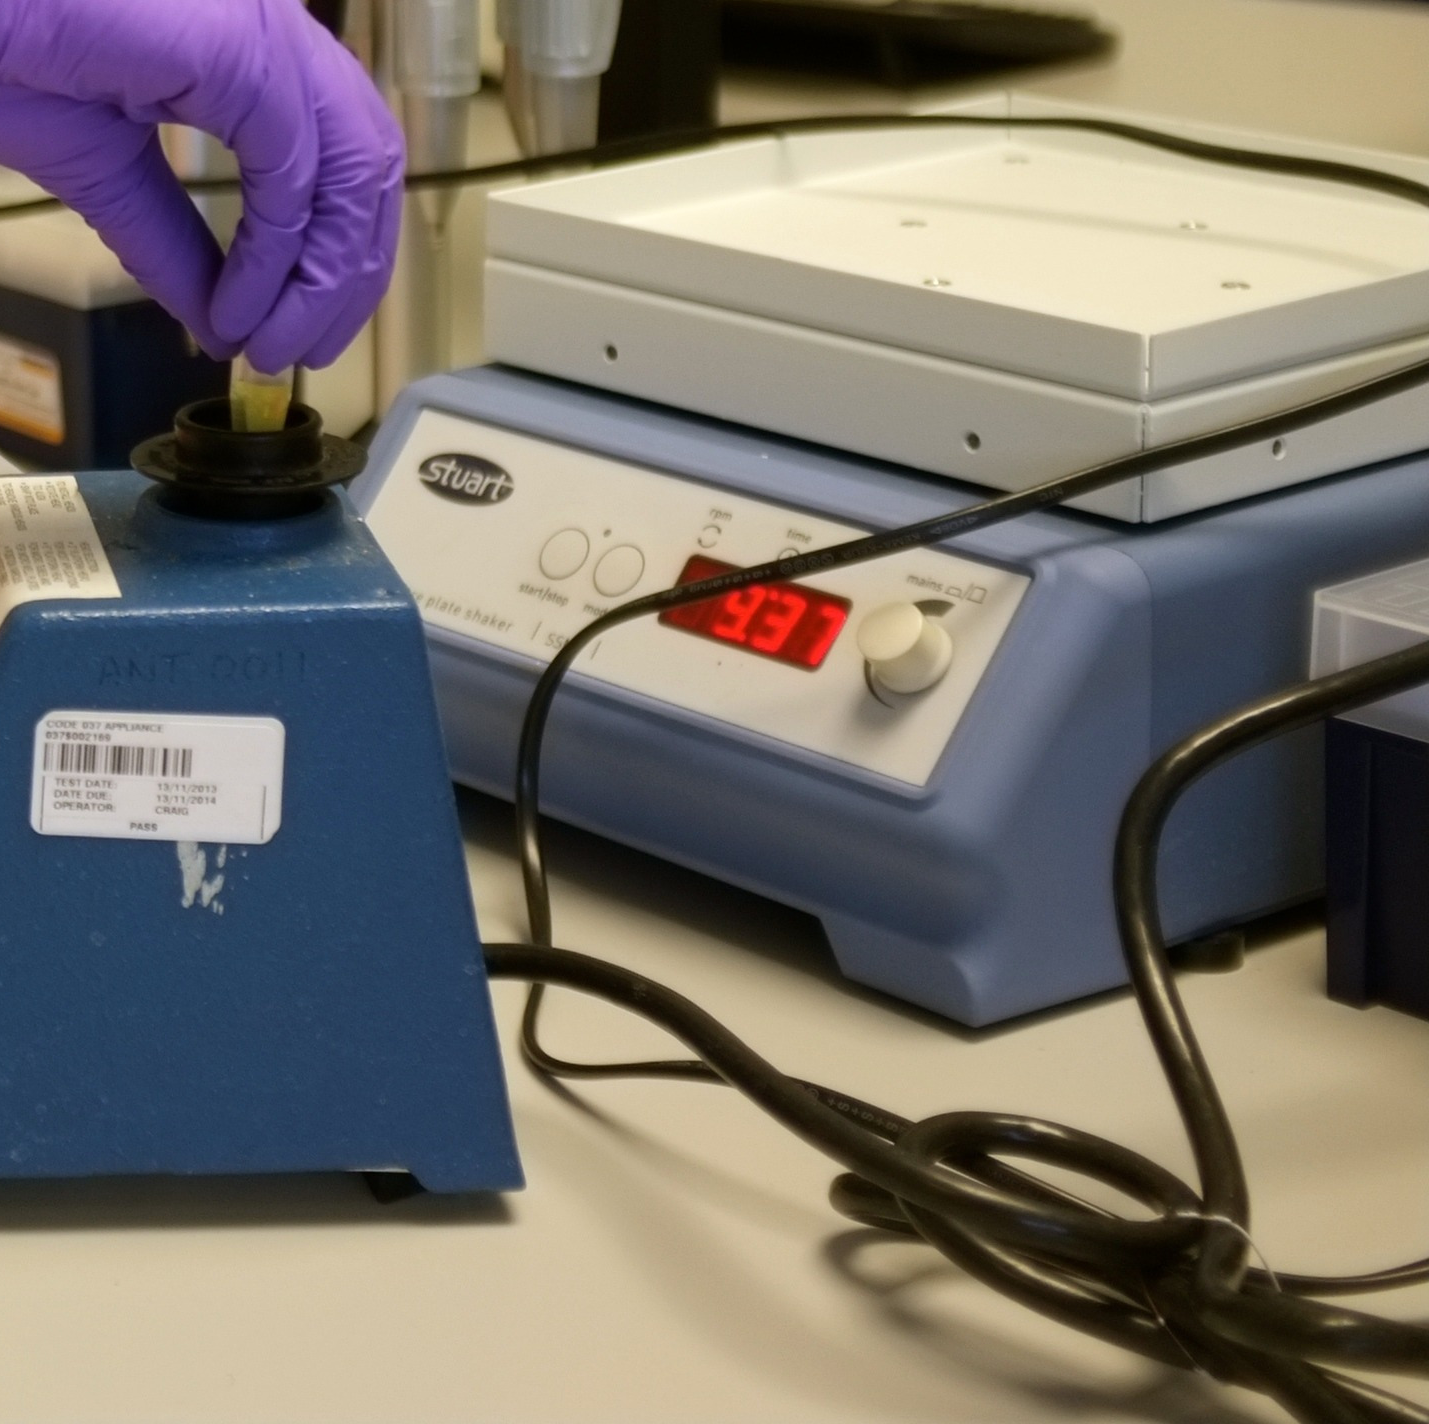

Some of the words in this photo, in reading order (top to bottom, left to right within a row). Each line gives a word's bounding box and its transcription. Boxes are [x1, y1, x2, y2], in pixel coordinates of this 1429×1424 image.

[419, 459, 515, 501] stuart
[709, 508, 733, 522] rpm
[787, 529, 812, 544] time
[907, 575, 943, 592] mains
[519, 582, 569, 608] start/stop
[425, 596, 461, 617] plate
[463, 608, 515, 632] shaker
[46, 719, 77, 729] CODE
[82, 721, 102, 730] 037
[104, 722, 164, 733] APPLIANCE
[55, 778, 81, 788] TEST
[85, 779, 118, 789] DATE:
[157, 782, 218, 794] 13/11/2013
[53, 789, 82, 800] DATE
[156, 794, 217, 805] 13/11/2014
[53, 801, 116, 813] OPERATOR:
[155, 805, 190, 816] CRAIG
[129, 821, 159, 832] PASS
